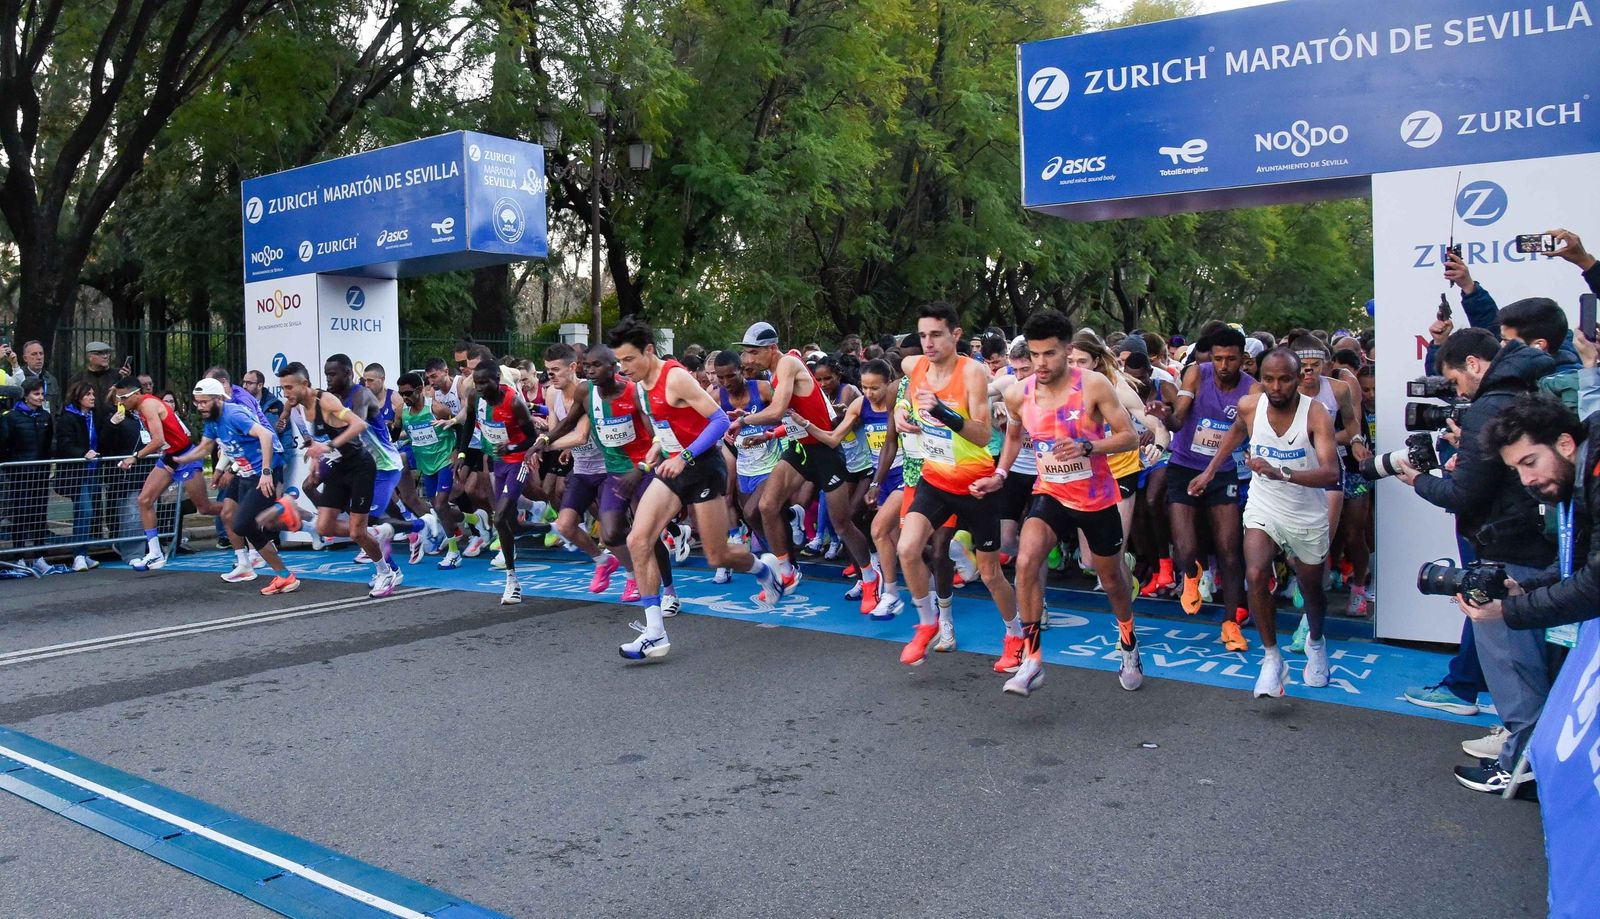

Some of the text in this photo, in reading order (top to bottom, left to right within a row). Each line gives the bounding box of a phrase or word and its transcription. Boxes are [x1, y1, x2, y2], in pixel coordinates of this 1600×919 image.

[1084, 55, 1207, 95] ZURICH
[1226, 28, 1378, 76] MARATÓN
[1390, 24, 1432, 54] DE
[1444, 2, 1592, 46] SEVILLA
[1457, 102, 1581, 136] ZURICH
[484, 150, 515, 164] ZURICH
[1321, 158, 1348, 167] SEVILLA
[1159, 166, 1208, 177] TotalEnergies
[268, 190, 317, 214] ZURICH
[324, 174, 382, 203] MARATÓN
[385, 172, 402, 190] DE
[405, 161, 459, 186] SEVILLA
[484, 176, 517, 190] SEVILLA
[317, 237, 357, 255] ZURICH
[330, 318, 381, 332] ZURICH
[605, 432, 628, 441] PACER
[1045, 462, 1084, 473] KHADIRI
